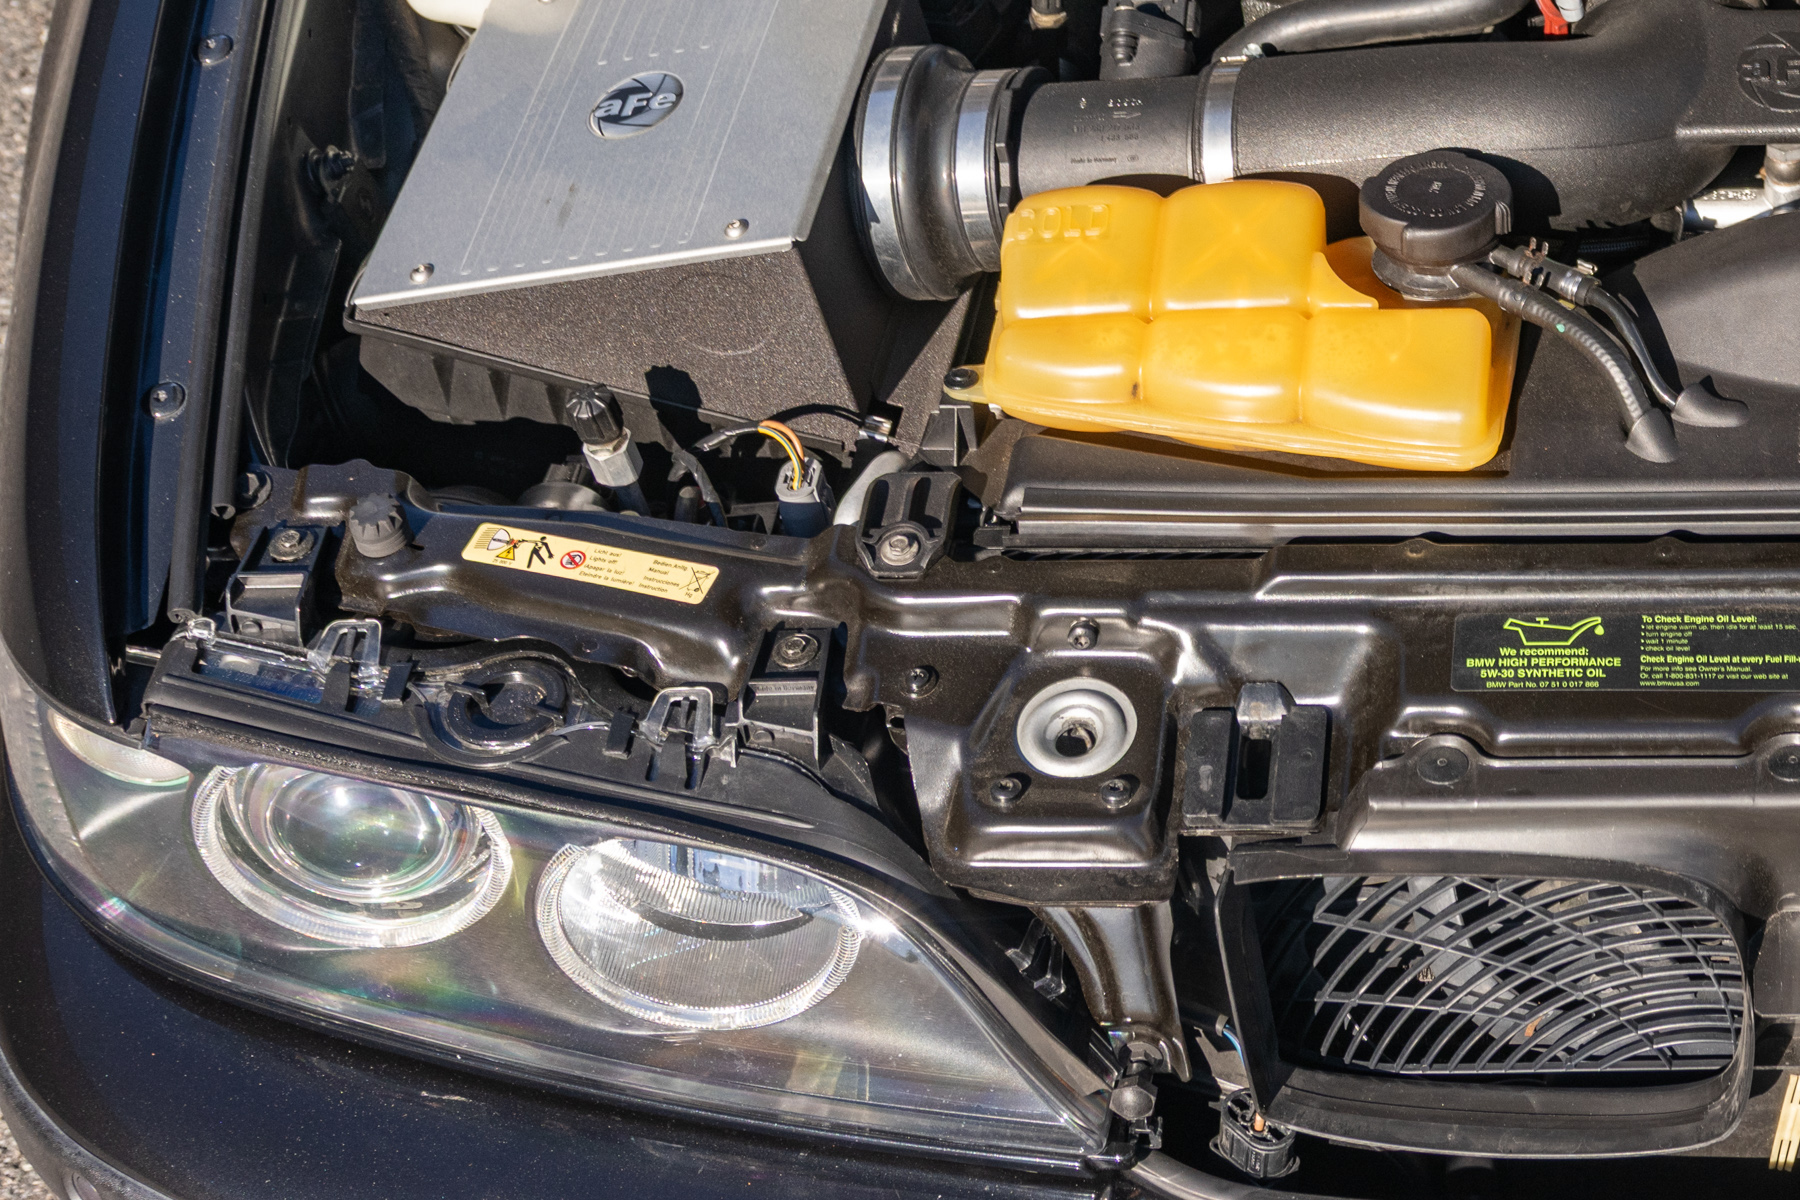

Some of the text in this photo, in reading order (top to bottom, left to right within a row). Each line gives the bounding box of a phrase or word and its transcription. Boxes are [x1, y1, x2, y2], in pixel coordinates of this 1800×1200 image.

[594, 92, 676, 118] aFe
[1016, 205, 1110, 241] COLD
[594, 548, 608, 556] Licht
[648, 567, 669, 575] Manual
[643, 576, 680, 587] Instrucciones
[638, 583, 668, 593] Instruction
[1642, 615, 1757, 625] To Check Engine Oil Level:
[1499, 647, 1589, 656] We recommend:
[1466, 657, 1621, 667] BMW HIGH PERFORMANCE
[1640, 655, 1665, 663] Check
[1667, 655, 1694, 664] Engine
[1696, 655, 1707, 663] Oil
[1709, 655, 1730, 663] Level
[1732, 655, 1740, 663] at
[1741, 656, 1763, 664] every
[1765, 655, 1782, 663] Fuel
[1480, 668, 1606, 678] 5W-30 SYNTHETIC OIL
